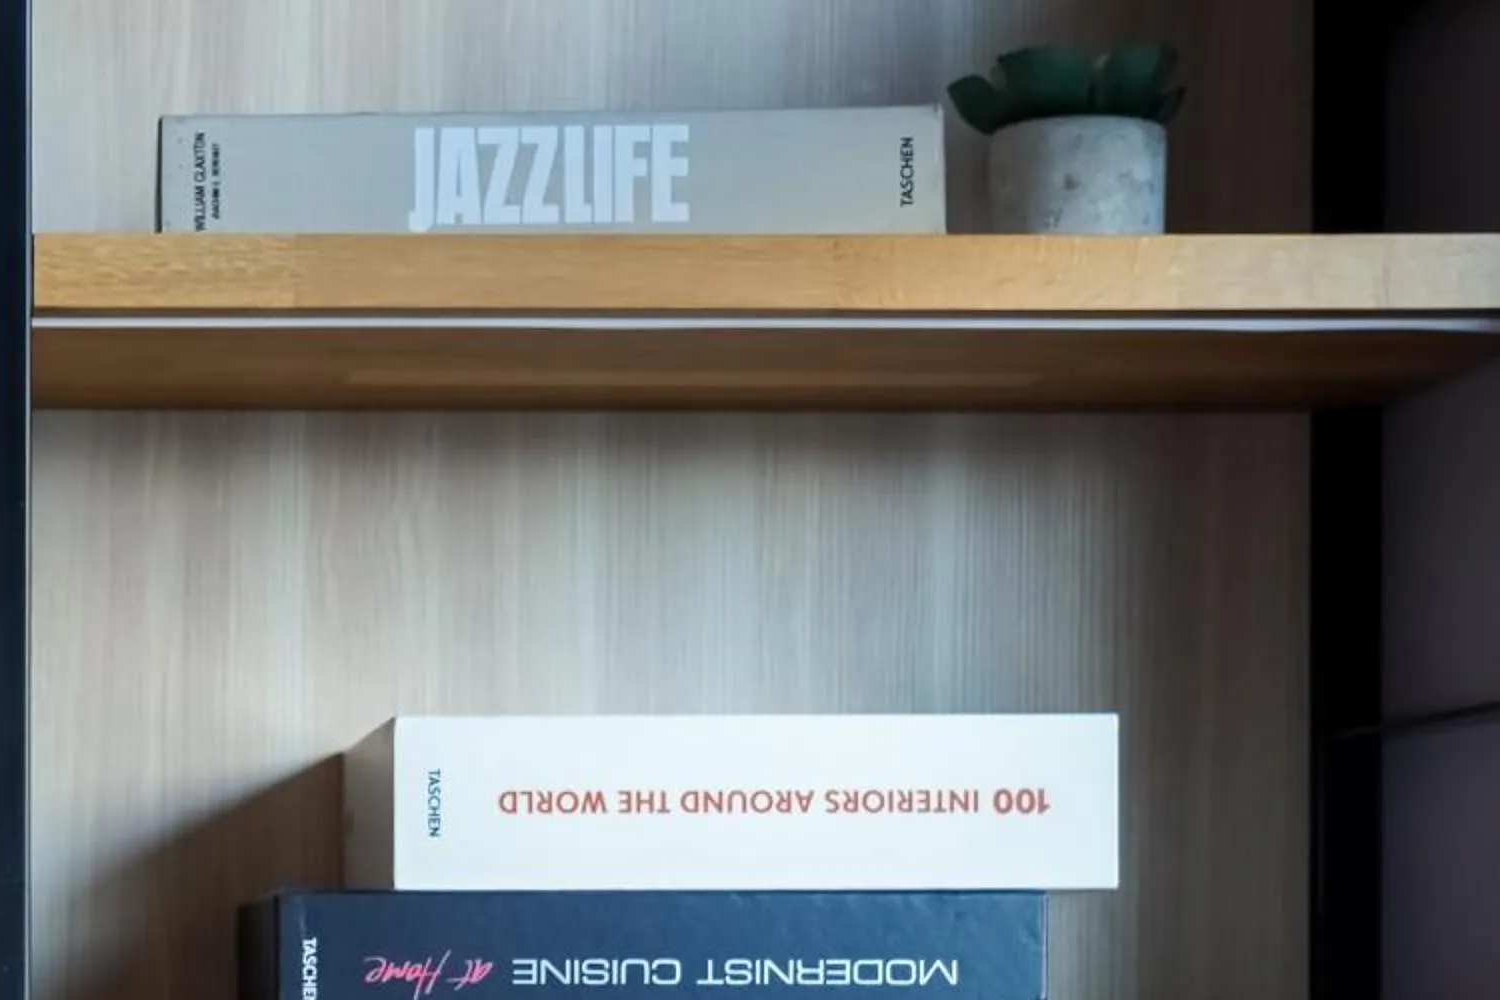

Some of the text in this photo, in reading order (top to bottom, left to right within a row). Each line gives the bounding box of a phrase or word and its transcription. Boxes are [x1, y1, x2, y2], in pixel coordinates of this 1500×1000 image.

[193, 132, 206, 232] WILLIAM CLAXTON
[408, 124, 690, 232] JAZZLIFE
[900, 136, 914, 207] TASCHEN
[428, 768, 441, 838] TASCHEN
[498, 788, 1049, 815] 100 INTERIORS AROUND THE WORLD
[446, 958, 494, 991] at
[512, 958, 682, 985] CUISINE
[696, 958, 958, 986] MODERNIST
